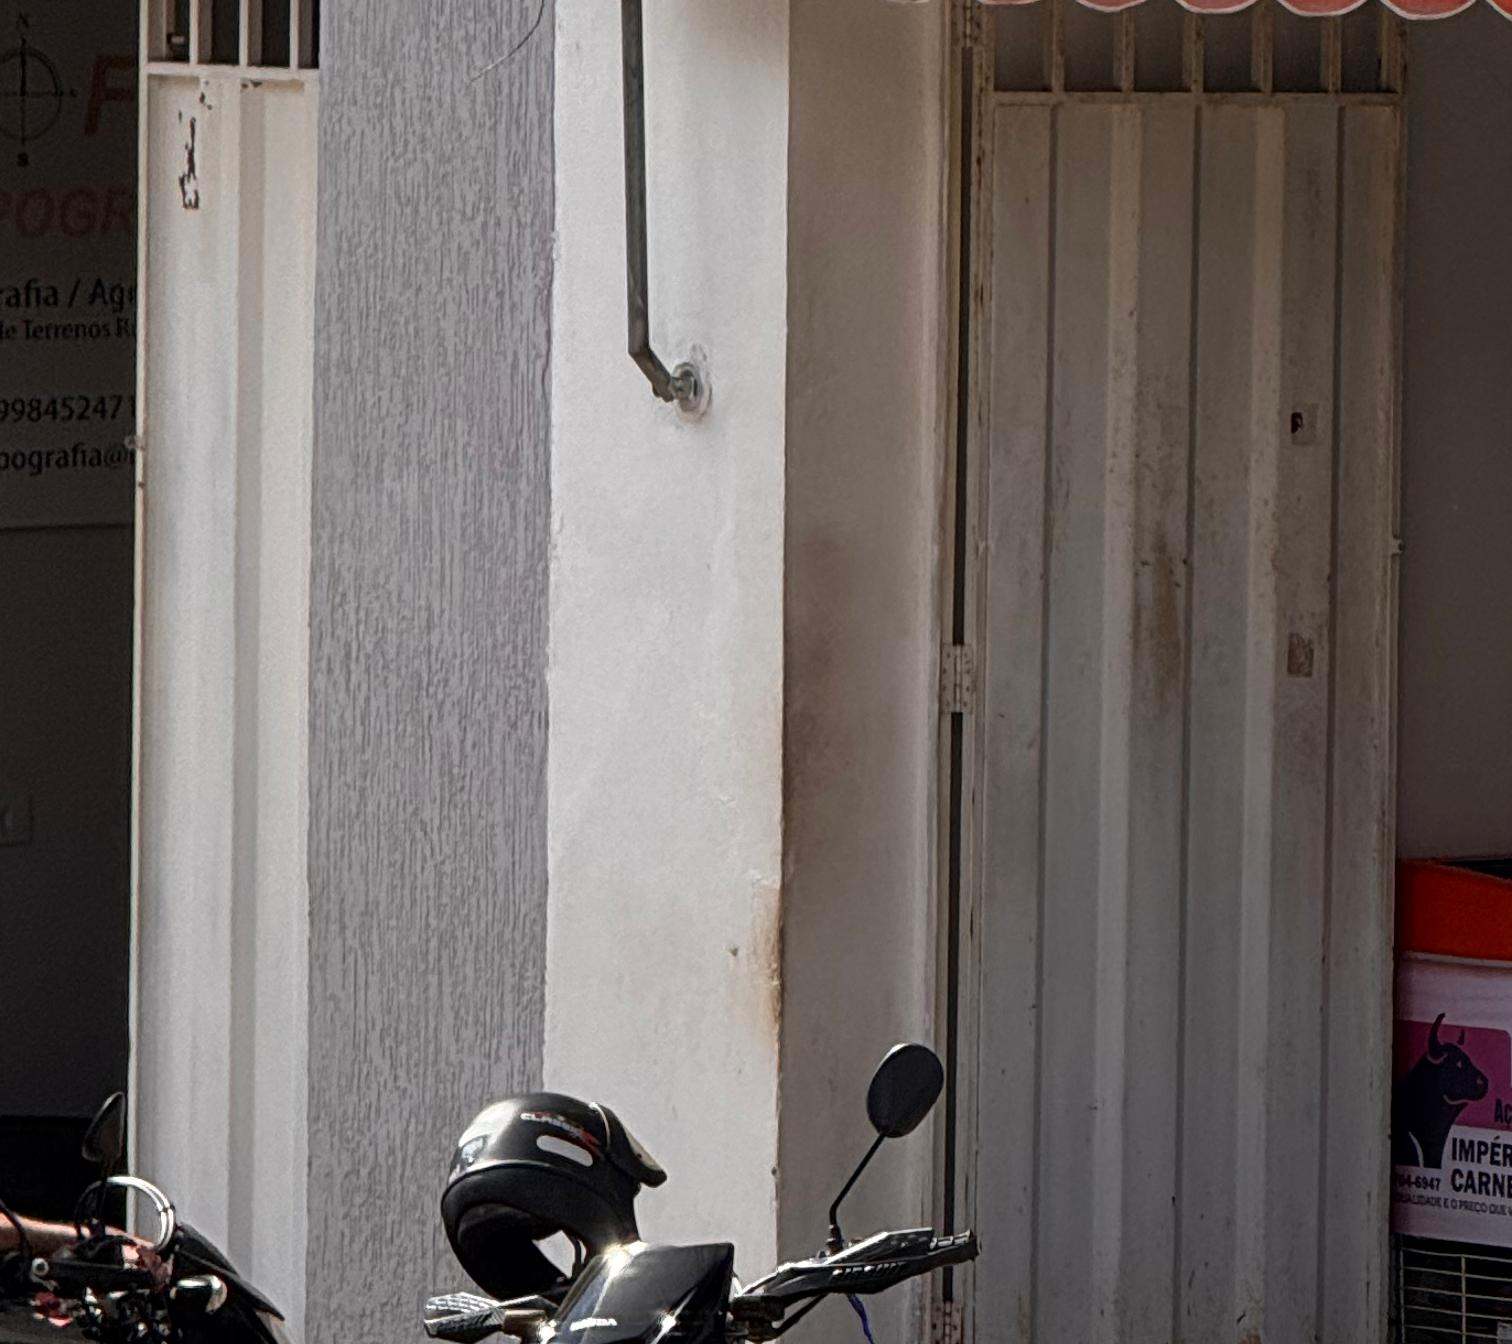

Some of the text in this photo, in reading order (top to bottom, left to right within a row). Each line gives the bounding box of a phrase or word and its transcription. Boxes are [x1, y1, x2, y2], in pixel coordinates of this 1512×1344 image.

[0, 278, 59, 308] afia
[88, 277, 135, 313] Ag
[22, 319, 111, 340] Terrenos
[1450, 1199, 1458, 1211] O
[1459, 1200, 1487, 1216] PREÇO
